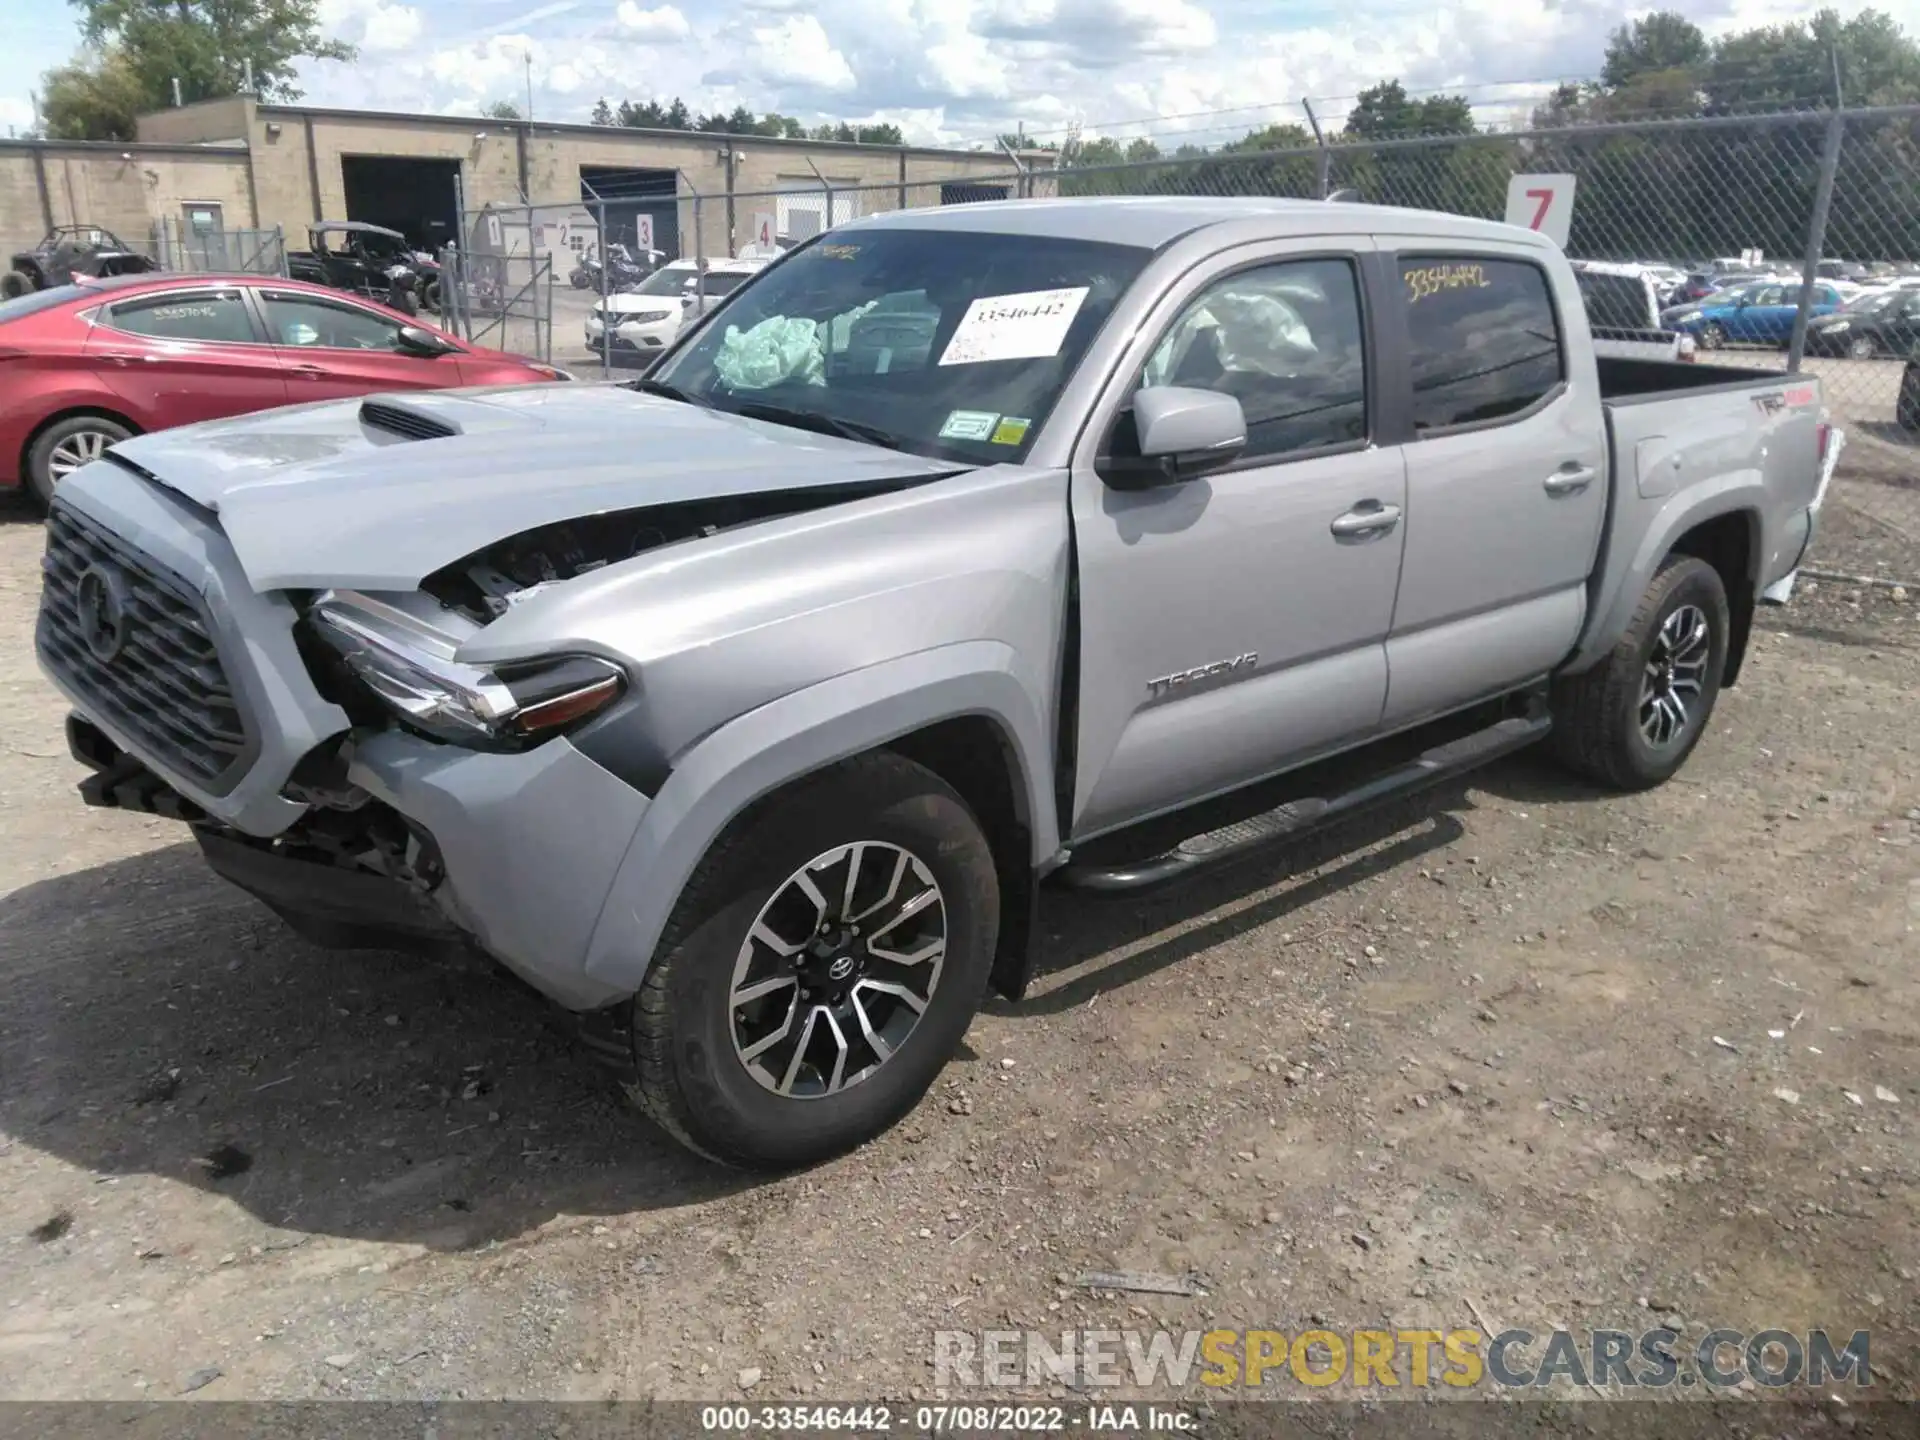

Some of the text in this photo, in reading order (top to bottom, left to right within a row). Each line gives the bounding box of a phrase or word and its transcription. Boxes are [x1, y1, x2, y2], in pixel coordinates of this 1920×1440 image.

[1525, 189, 1555, 231] 7
[559, 224, 568, 246] 2
[640, 220, 650, 245] 3
[759, 220, 770, 247] 4
[1404, 264, 1491, 304] 33546442
